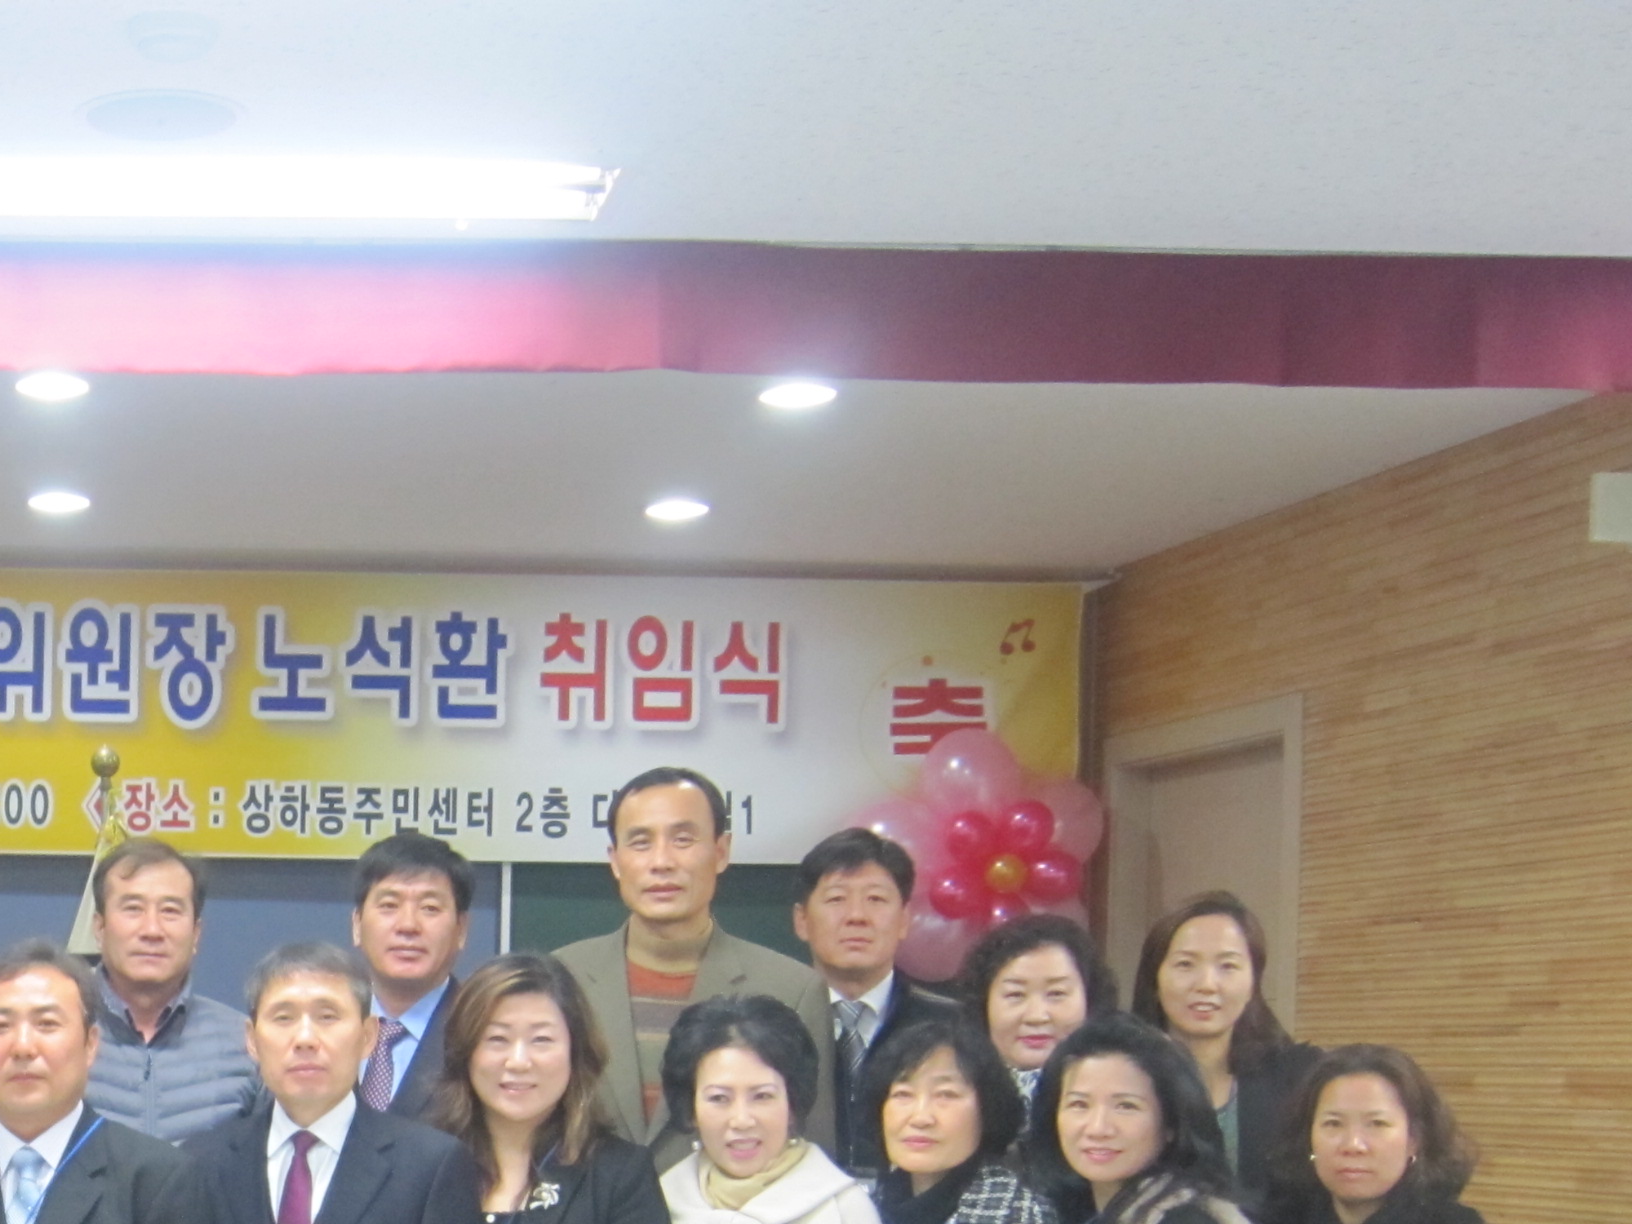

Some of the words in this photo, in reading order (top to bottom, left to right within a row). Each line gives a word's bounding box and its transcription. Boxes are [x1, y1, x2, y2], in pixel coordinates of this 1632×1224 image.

[258, 610, 508, 720] 노석환
[540, 612, 781, 725] 취임식
[123, 783, 191, 833] 장소
[242, 786, 495, 837] 상하동주민센터
[516, 787, 571, 839] 2층
